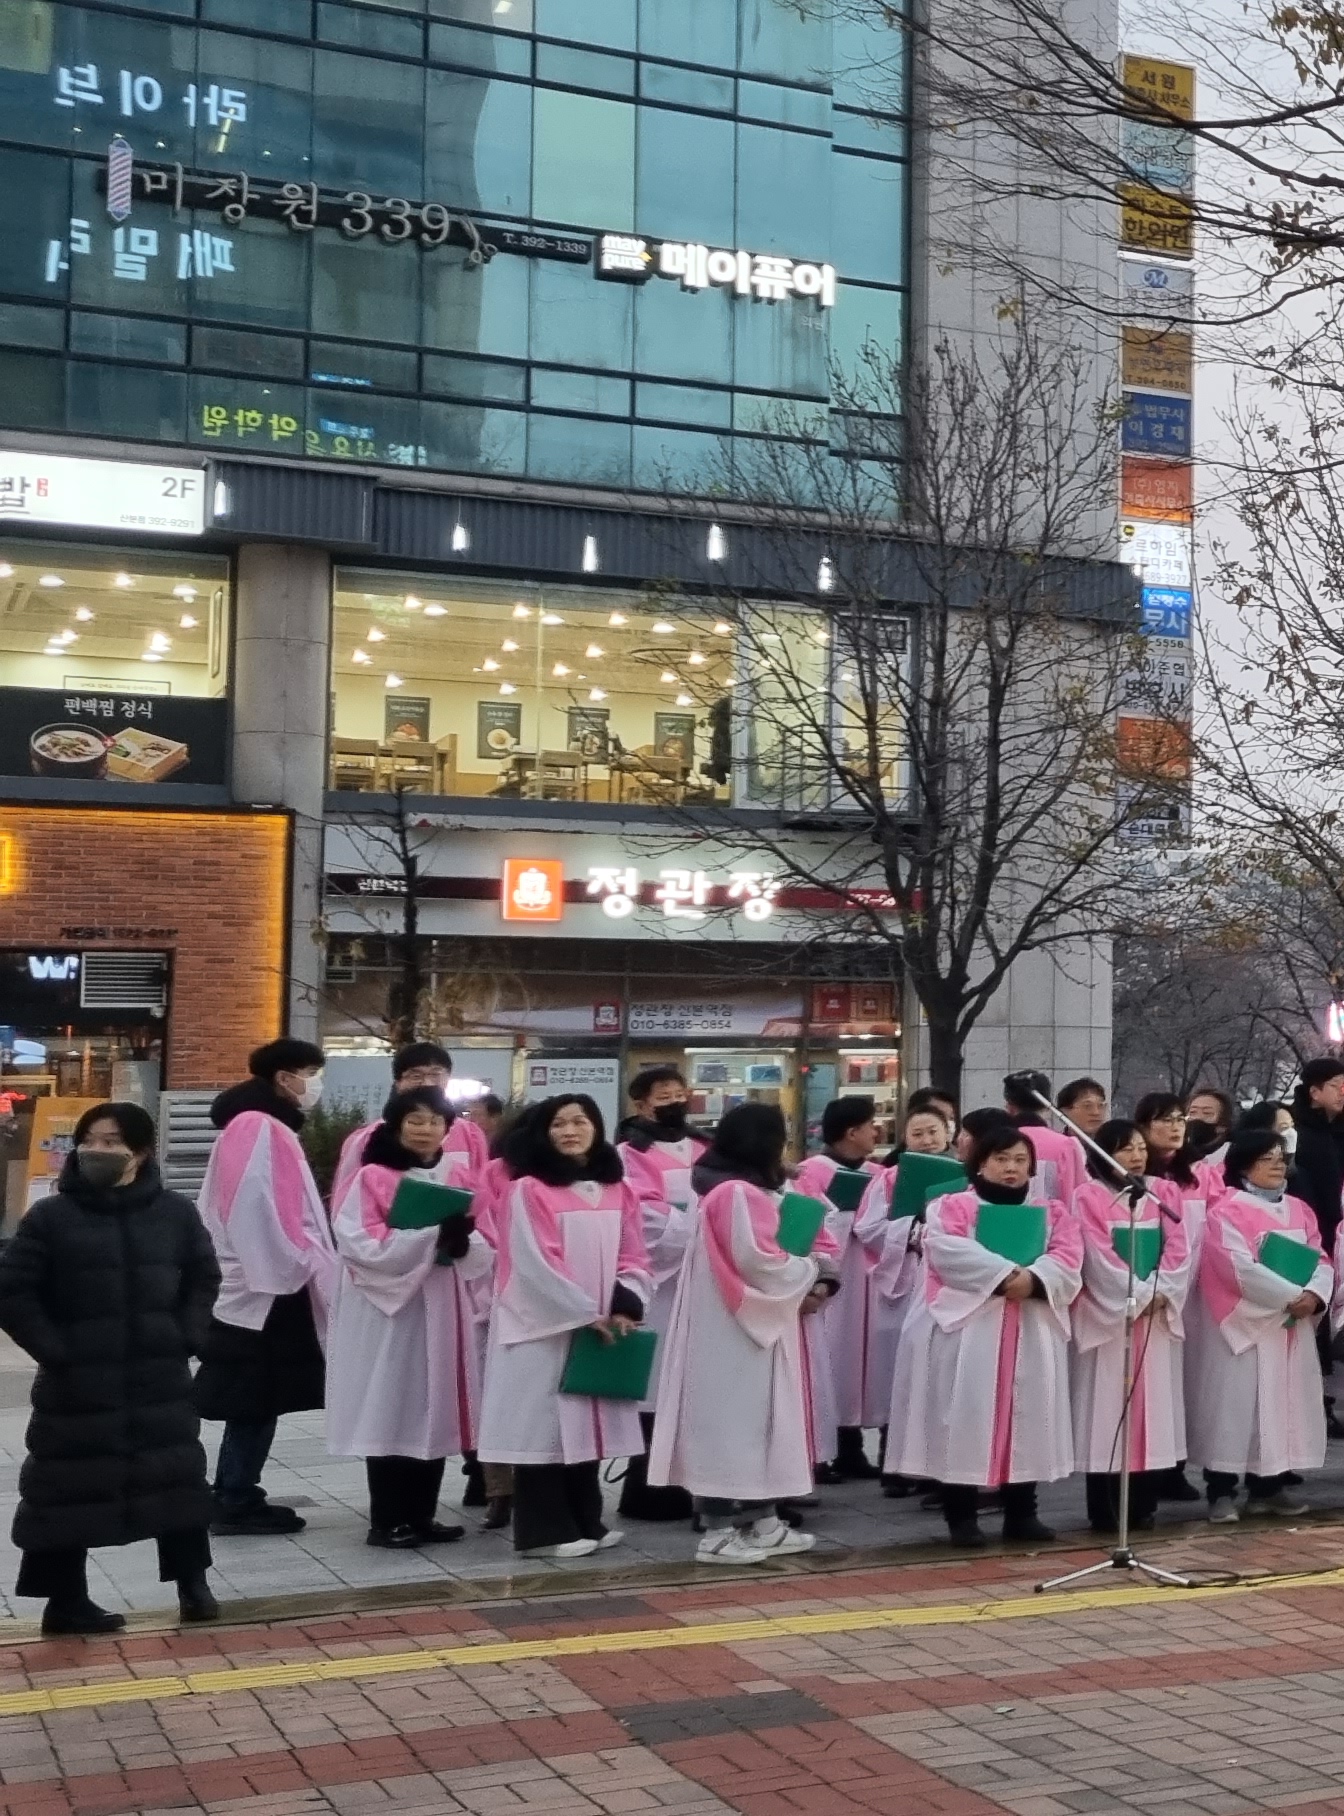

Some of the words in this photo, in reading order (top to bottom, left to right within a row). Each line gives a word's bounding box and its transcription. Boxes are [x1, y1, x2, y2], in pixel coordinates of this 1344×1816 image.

[142, 161, 317, 231] 미장원
[342, 191, 449, 244] 339
[602, 235, 647, 254] may
[602, 252, 647, 271] pure
[659, 242, 836, 307] 메이퓨어
[161, 476, 197, 499] 2F
[64, 696, 115, 717] 편백찜
[120, 700, 153, 719] 정식
[587, 867, 783, 922] 정관장
